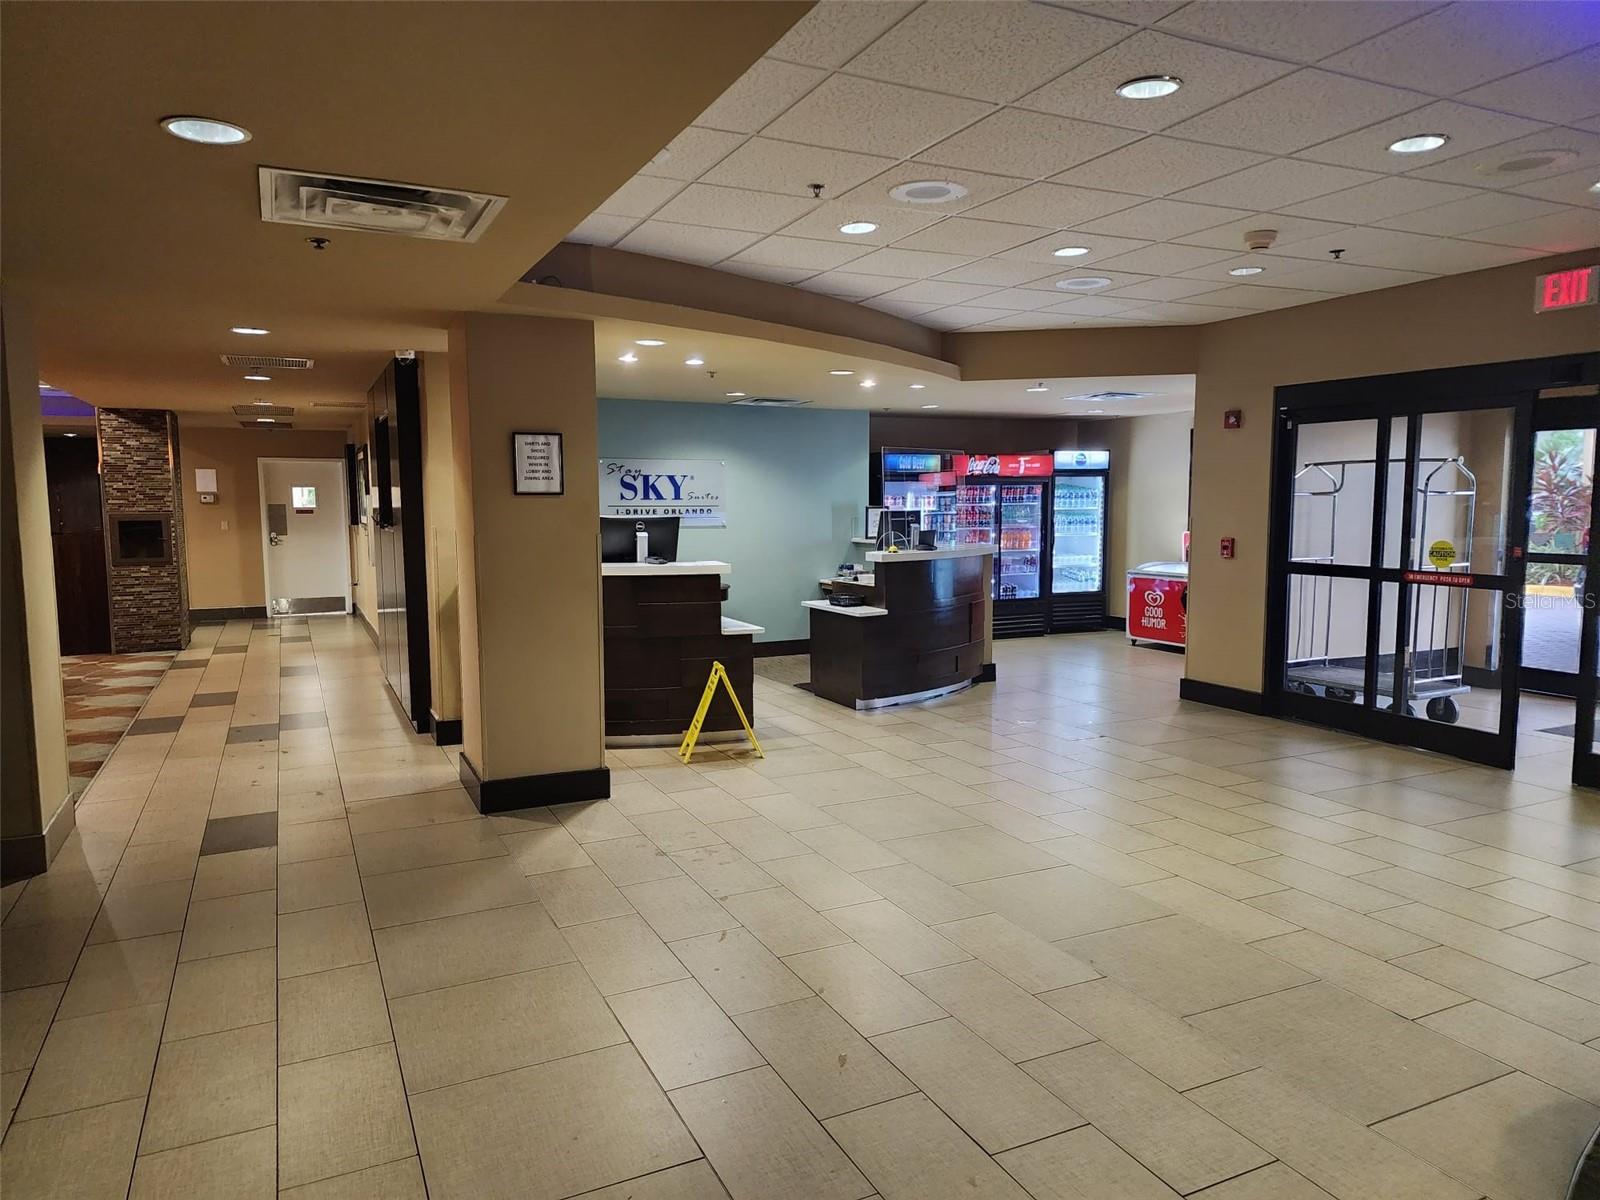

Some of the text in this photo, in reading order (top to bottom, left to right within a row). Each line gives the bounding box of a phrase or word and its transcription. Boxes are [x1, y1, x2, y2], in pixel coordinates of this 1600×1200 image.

[1542, 268, 1591, 307] EXIT
[606, 462, 642, 481] Stay
[620, 473, 689, 501] SKY
[1413, 573, 1438, 581] EMERGENCY
[1144, 606, 1163, 617] GOOD
[1141, 617, 1167, 629] HUMOR
